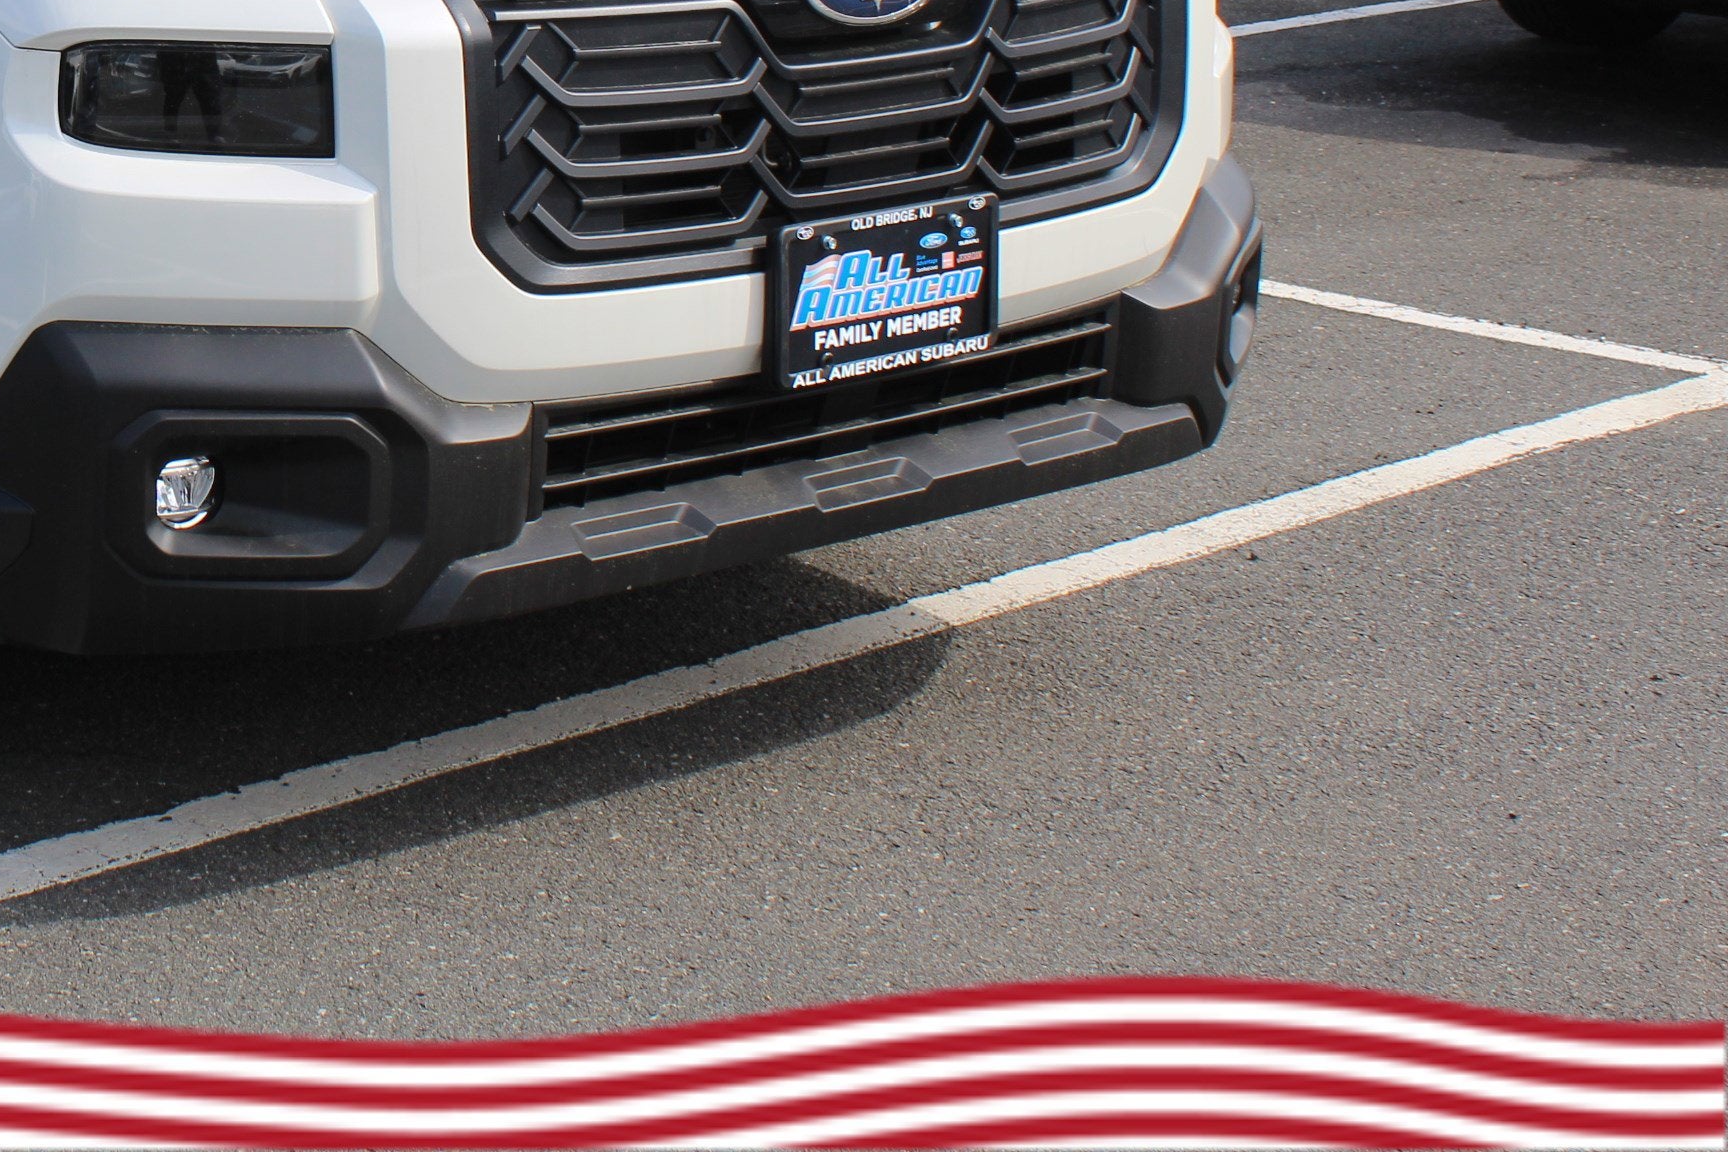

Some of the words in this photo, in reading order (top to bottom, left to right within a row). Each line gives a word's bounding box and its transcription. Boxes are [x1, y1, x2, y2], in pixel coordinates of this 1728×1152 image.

[851, 218, 874, 231] OLD
[875, 209, 917, 226] BRIDGE,
[919, 206, 934, 218] NJ
[833, 250, 910, 290] ALL
[790, 266, 983, 331] AMERICAN
[814, 321, 882, 350] FAMILY
[887, 306, 962, 338] MEMBER
[793, 371, 827, 388] ALL
[829, 353, 918, 380] AMERICAN
[920, 336, 989, 361] SUBARU
